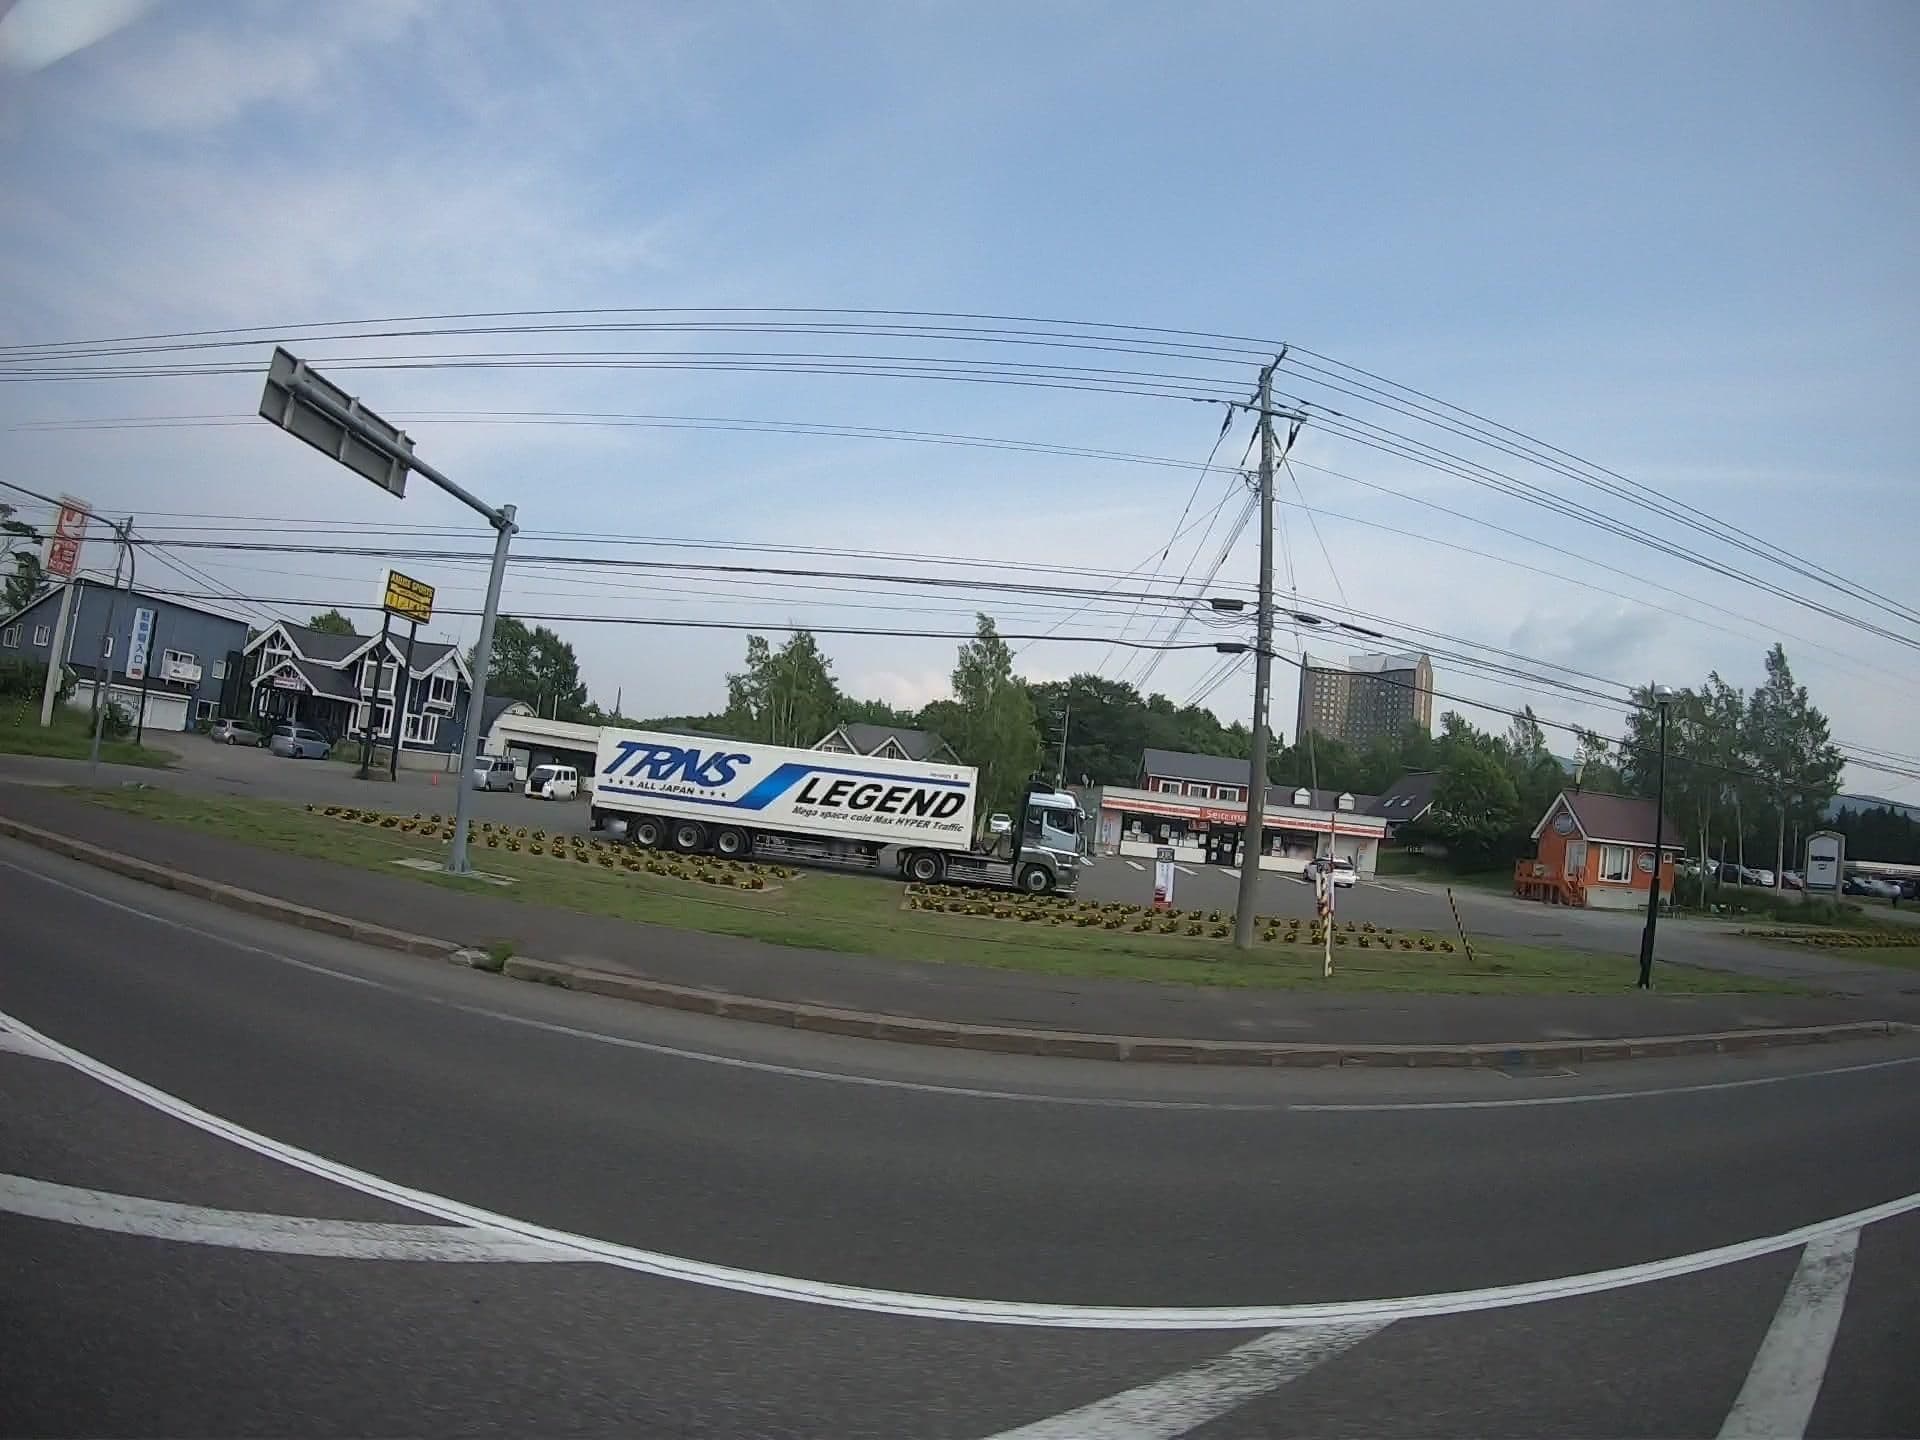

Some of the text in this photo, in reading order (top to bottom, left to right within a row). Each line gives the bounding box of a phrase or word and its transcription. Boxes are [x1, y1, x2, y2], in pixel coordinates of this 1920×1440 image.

[637, 781, 695, 795] ALL JAPAN
[795, 777, 966, 818] LEGEND
[792, 805, 965, 832] Mega space cold Max HYPER Traffic
